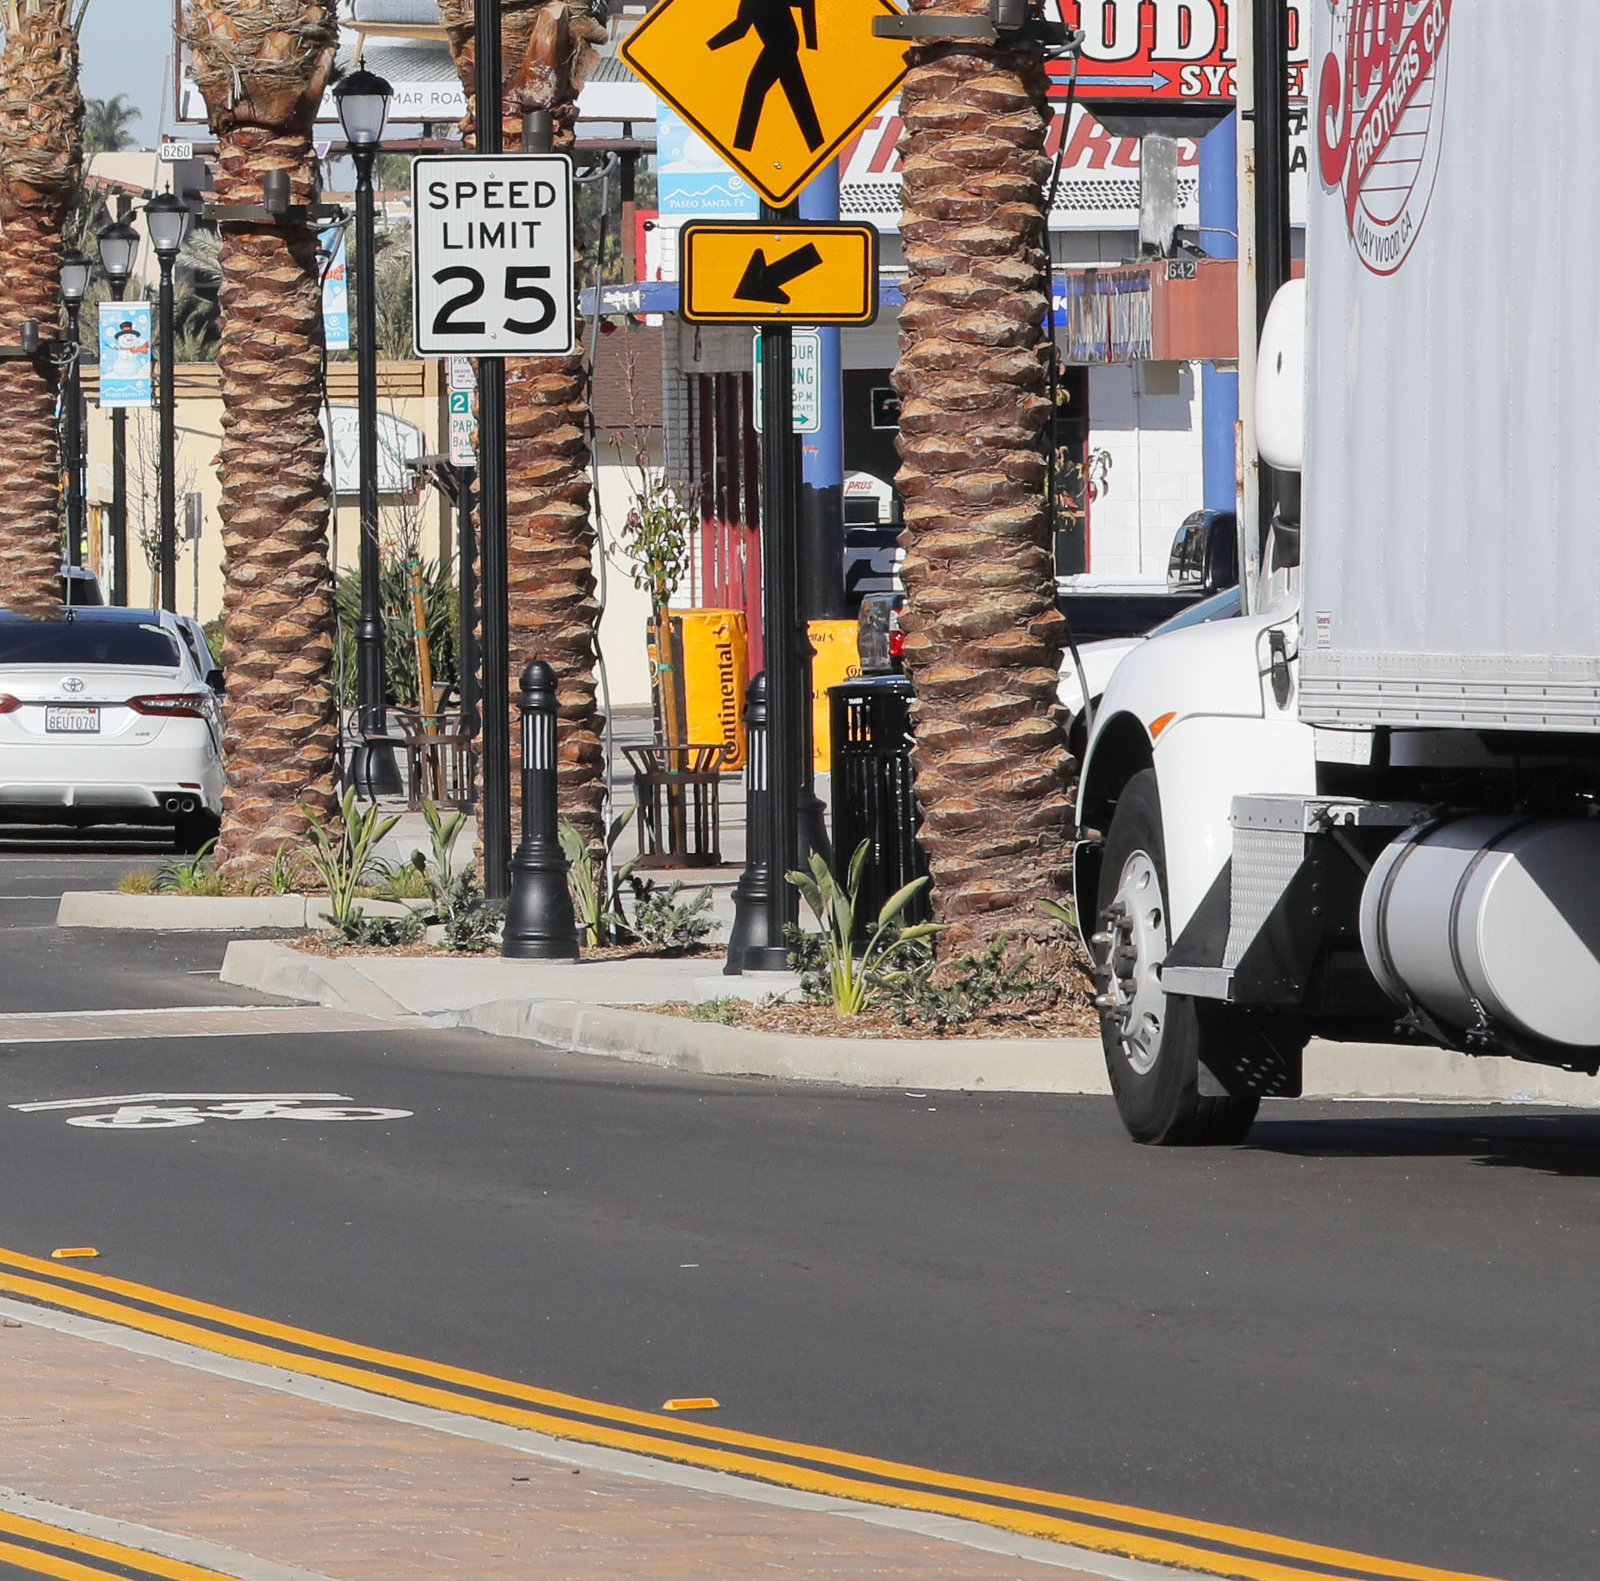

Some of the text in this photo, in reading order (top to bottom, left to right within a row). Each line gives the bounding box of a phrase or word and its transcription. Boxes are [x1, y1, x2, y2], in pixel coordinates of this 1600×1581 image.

[391, 92, 470, 105] MAR ROA
[1355, 38, 1420, 178] BROTHERS
[163, 145, 190, 158] 6260
[428, 181, 556, 210] SPEED
[670, 198, 745, 209] PASEO SANTA FE
[1400, 209, 1413, 244] CA
[442, 221, 542, 250] LIMIT
[1168, 263, 1195, 279] 642
[431, 265, 557, 336] 25
[792, 344, 814, 360] OUR
[453, 394, 466, 412] 2
[48, 716, 96, 729] 8EUT070
